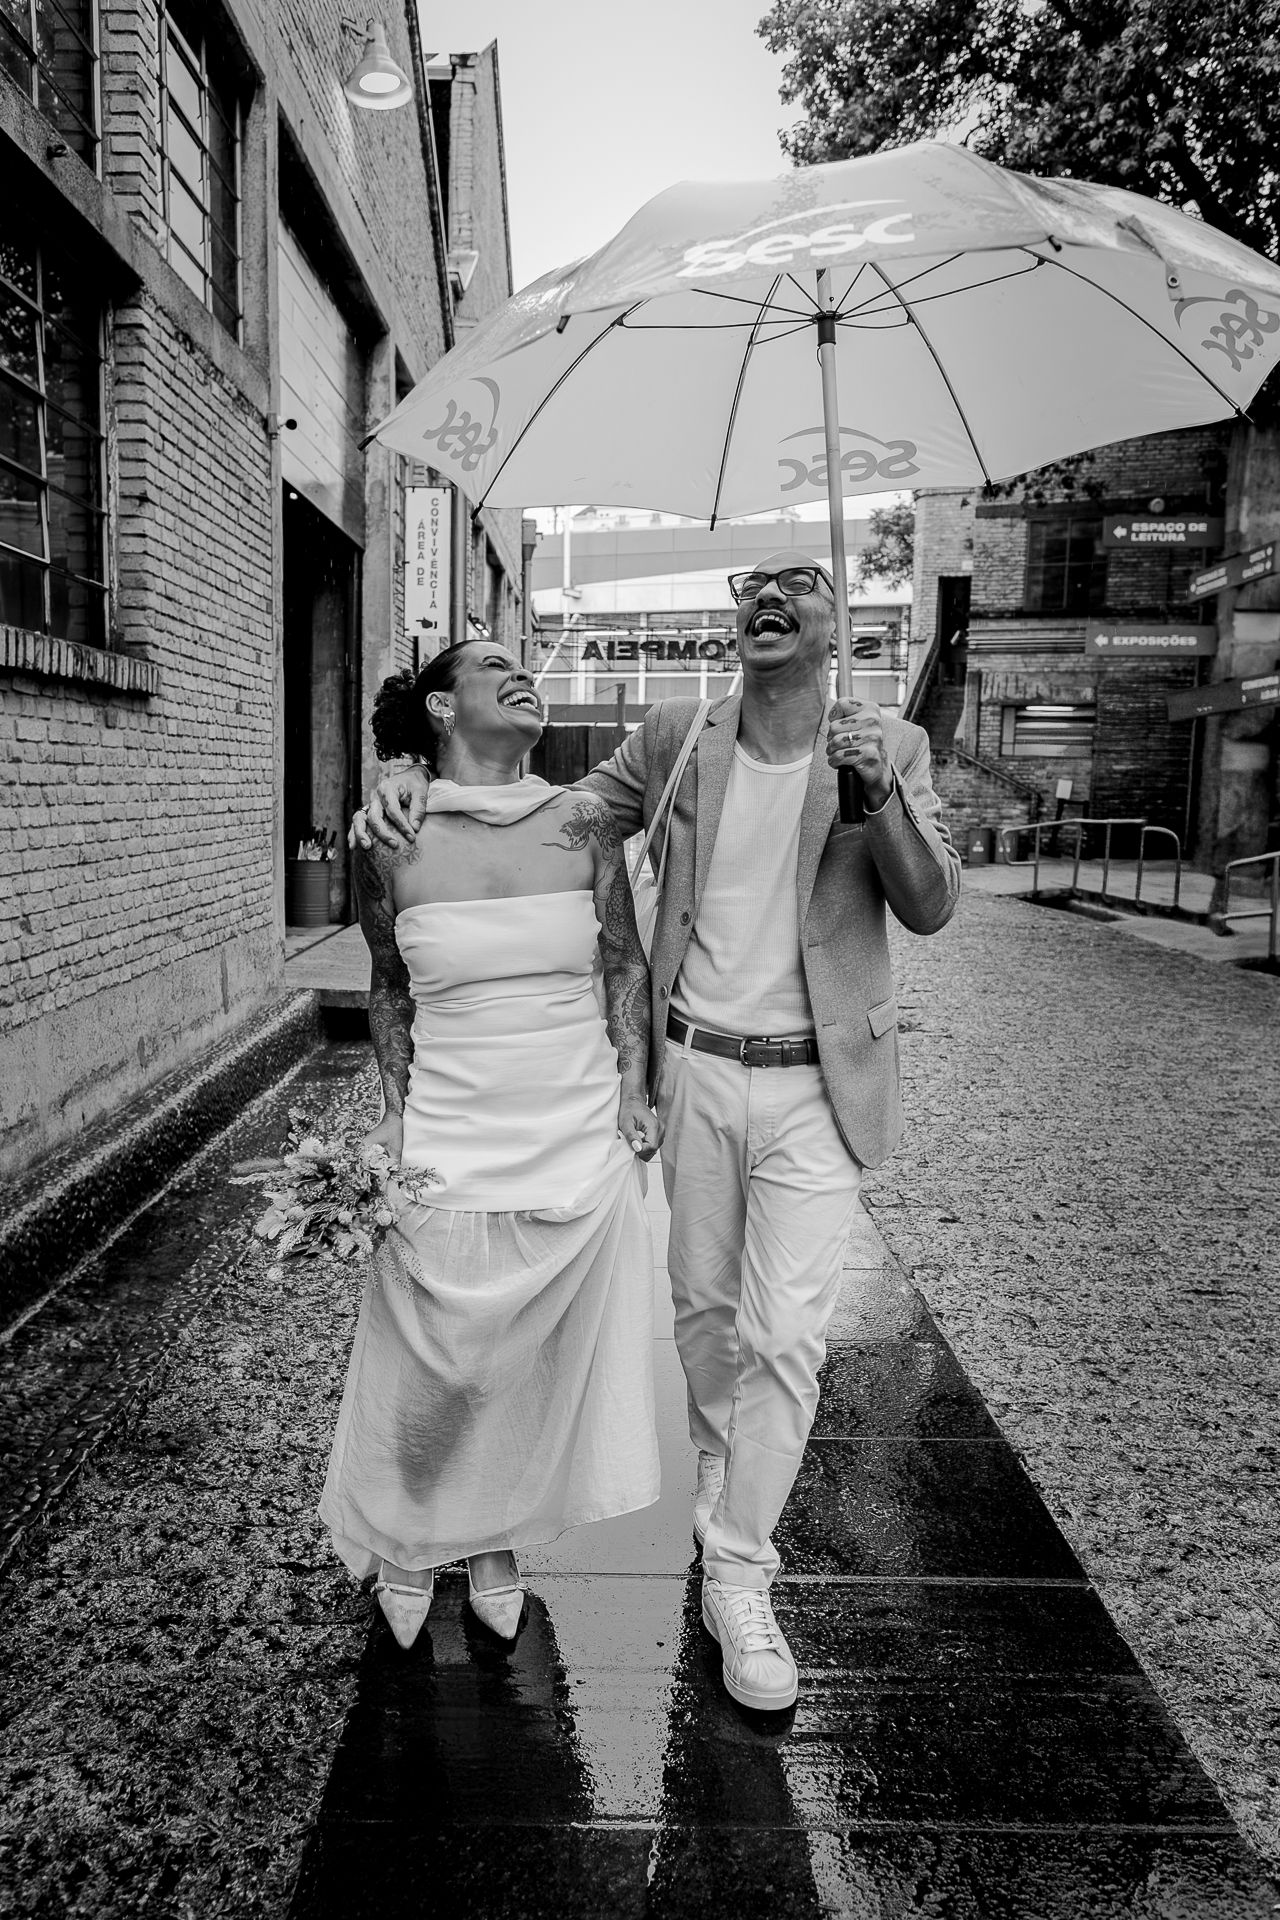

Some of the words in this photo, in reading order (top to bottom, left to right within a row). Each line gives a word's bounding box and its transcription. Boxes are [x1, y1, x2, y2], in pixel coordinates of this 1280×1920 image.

[1131, 522, 1186, 533] ESPAÇO
[1188, 522, 1208, 532] DE
[1130, 532, 1186, 541] LEITURA
[416, 567, 425, 586] DE
[1112, 634, 1197, 647] EXPOSIÇÕES
